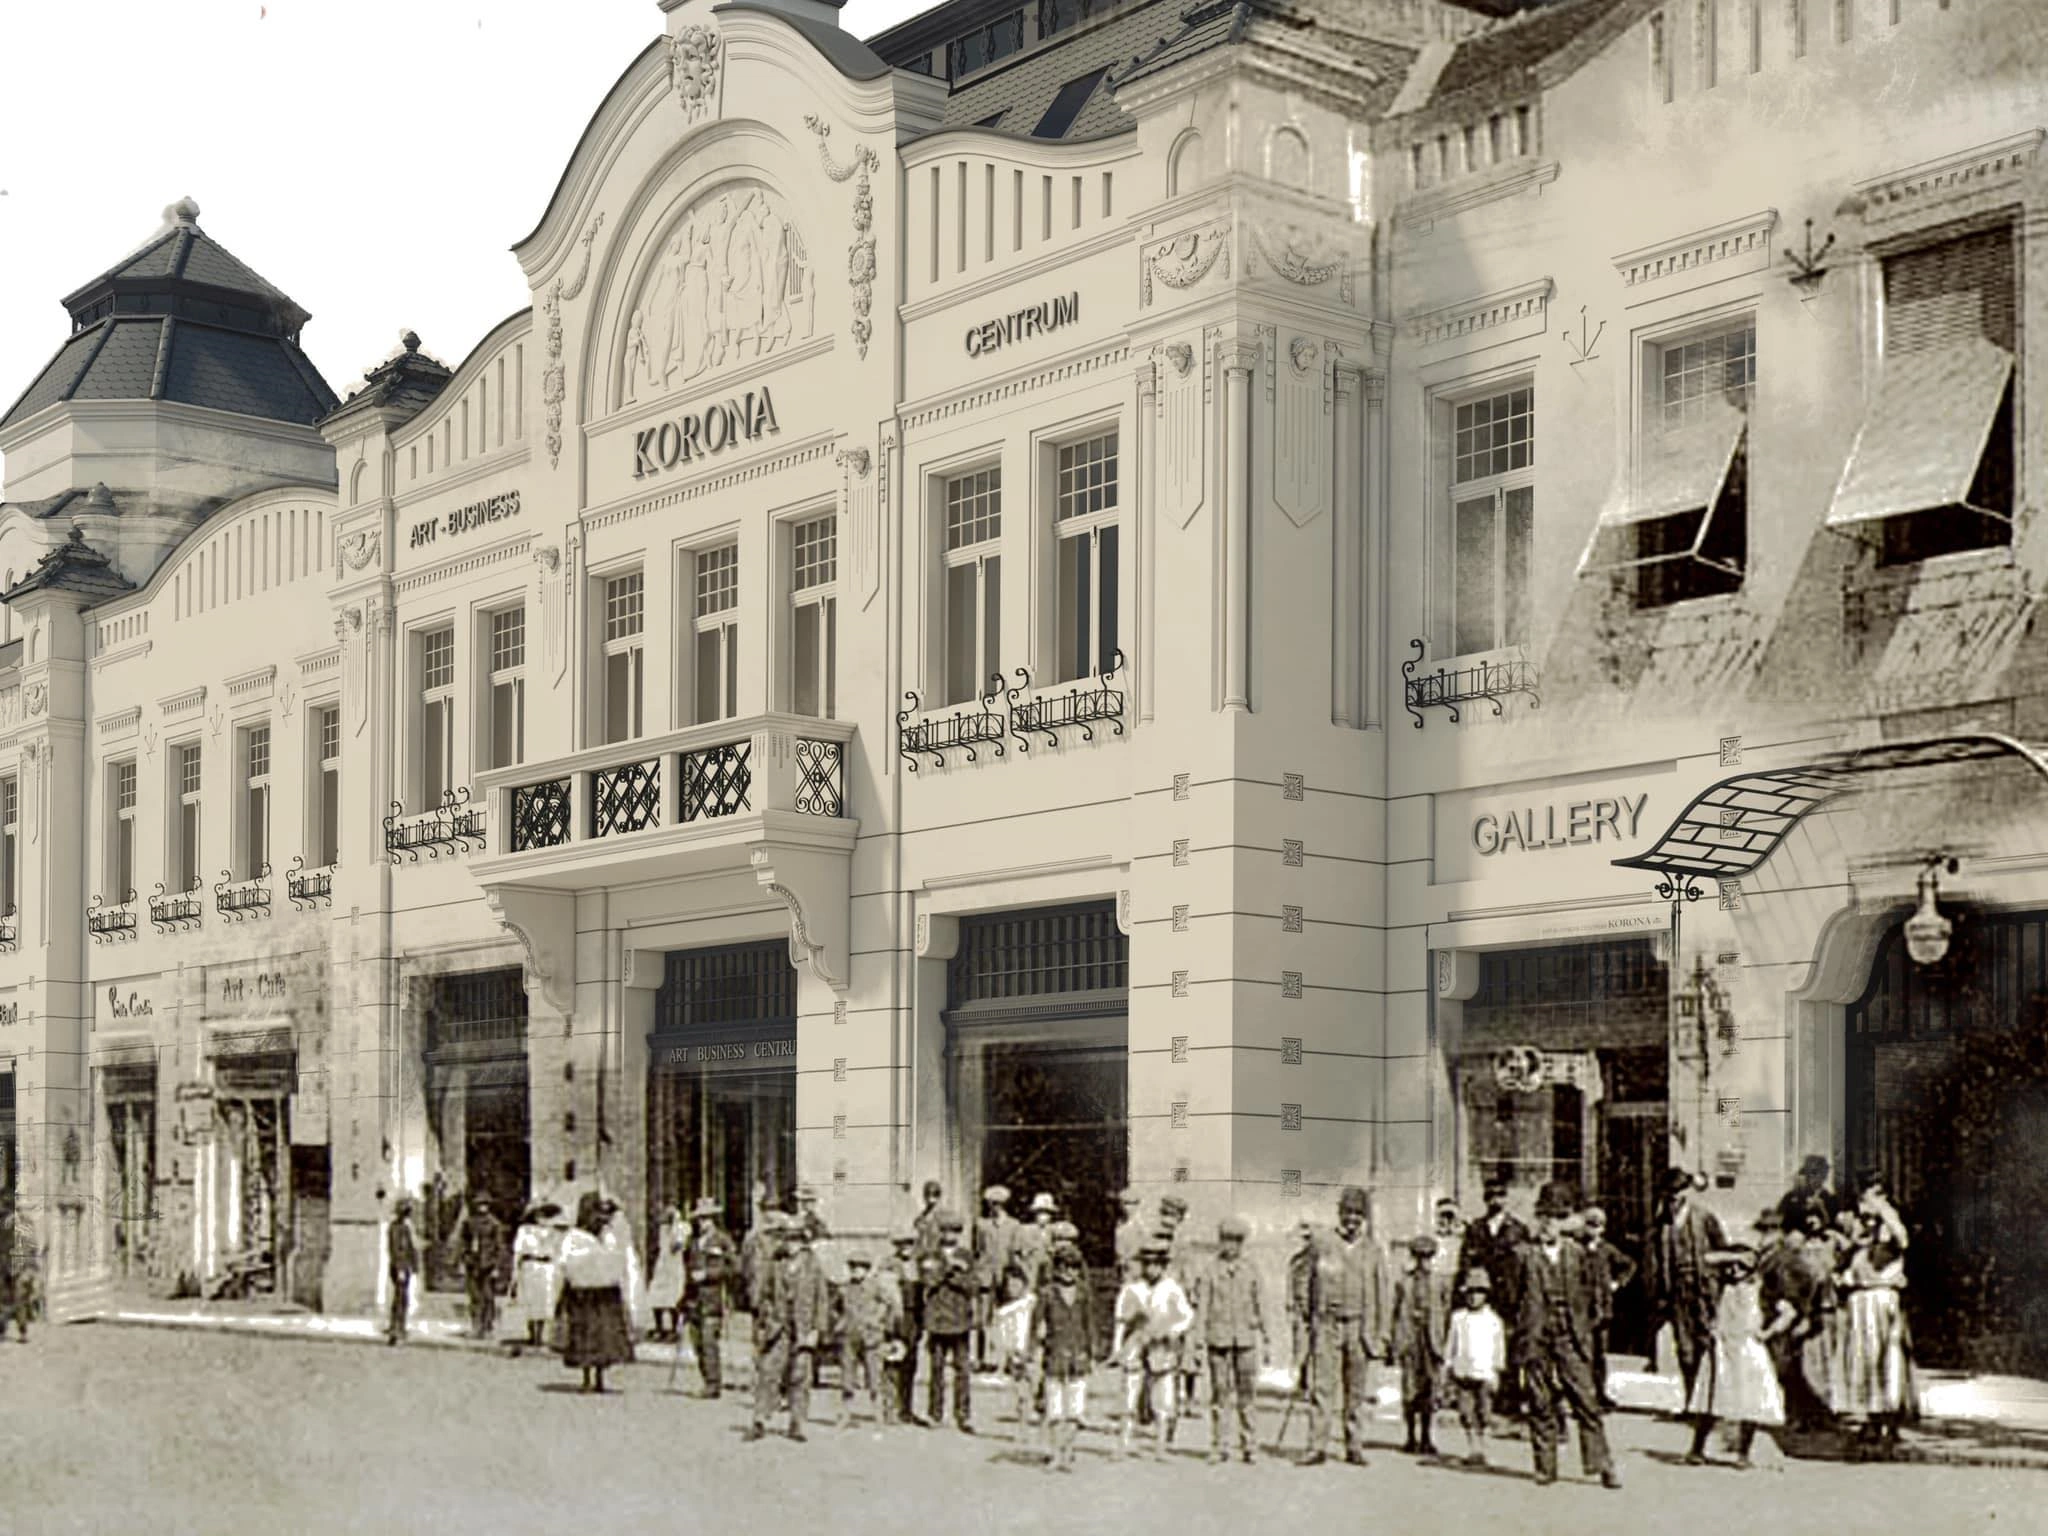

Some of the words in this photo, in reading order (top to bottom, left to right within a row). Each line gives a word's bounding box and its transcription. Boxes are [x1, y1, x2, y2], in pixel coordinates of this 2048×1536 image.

[965, 291, 1079, 358] CENTRUM
[632, 385, 781, 480] KORONA
[448, 489, 521, 536] BUSINESS
[1471, 793, 1648, 855] GALLERY
[1608, 916, 1652, 929] KORONA
[670, 1047, 689, 1063] ART
[697, 1042, 746, 1061] BUSINESS
[754, 1039, 797, 1058] CENTRU
